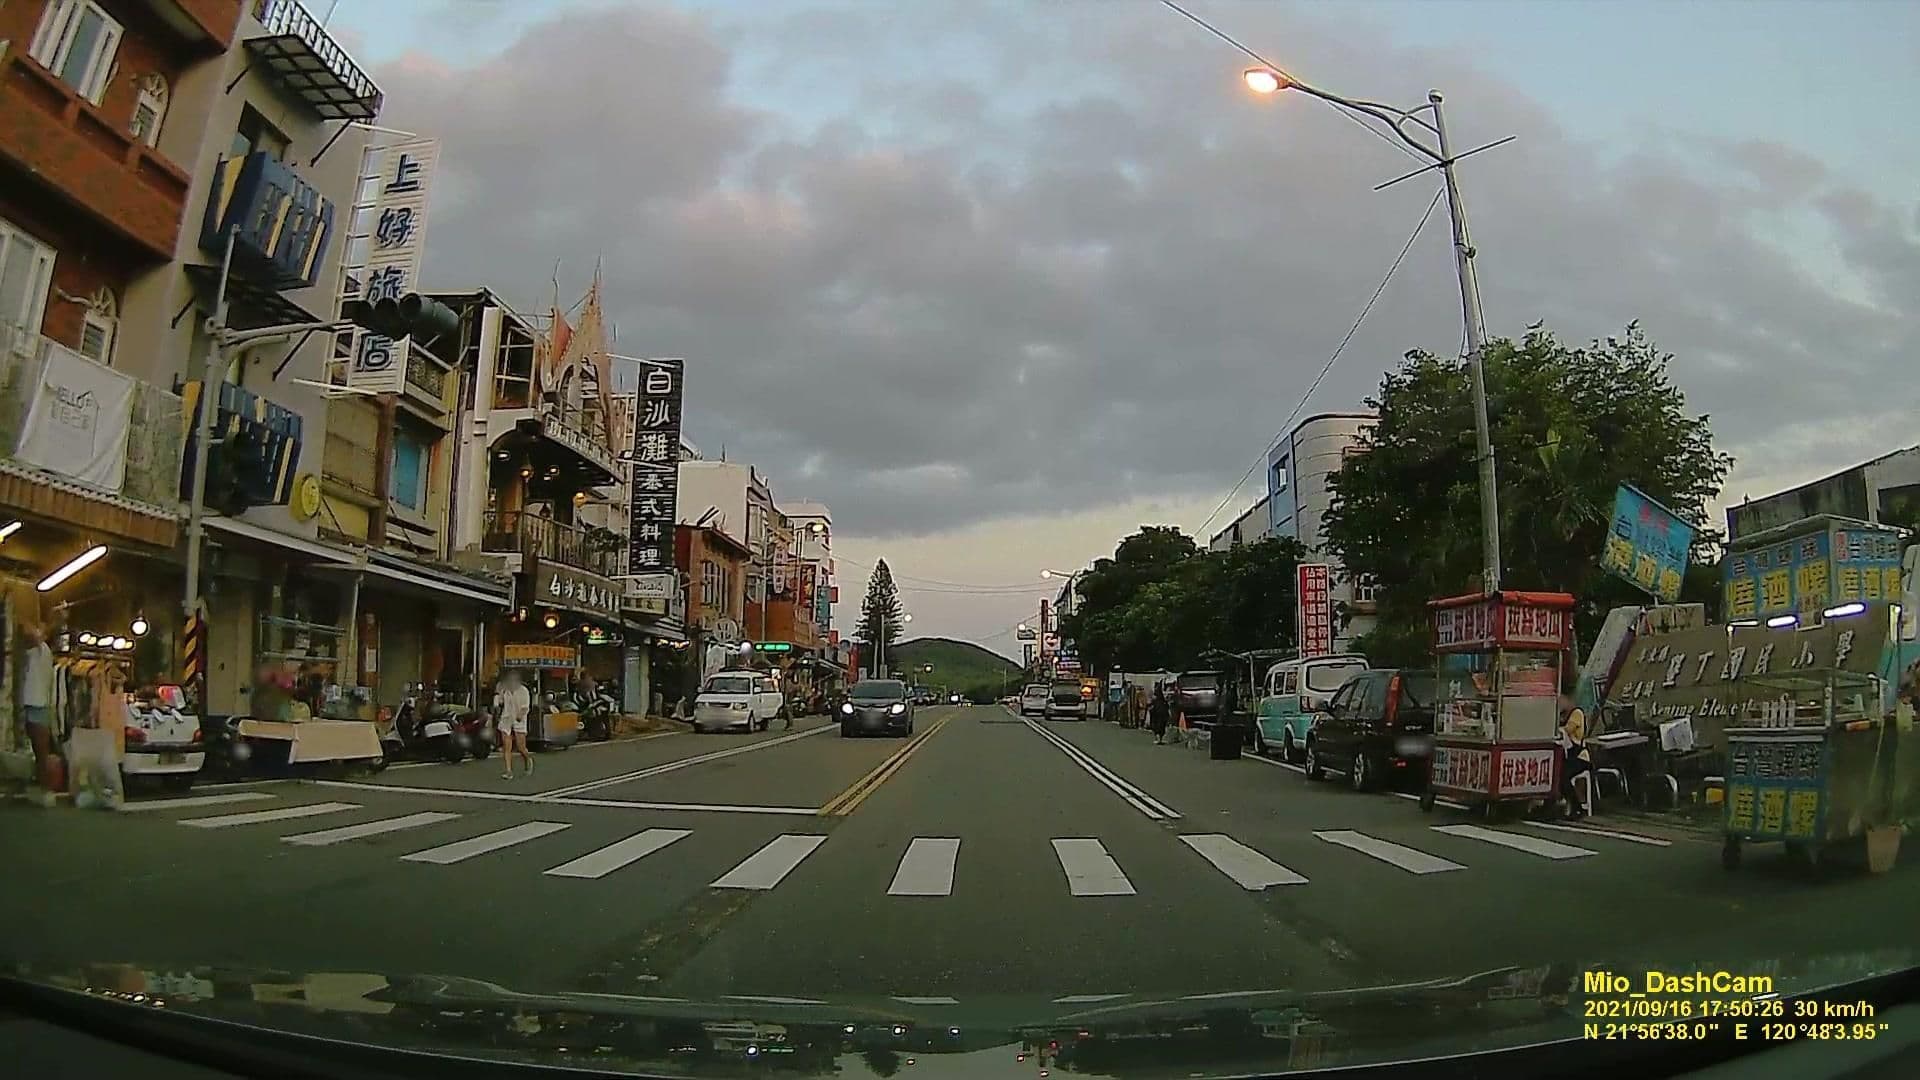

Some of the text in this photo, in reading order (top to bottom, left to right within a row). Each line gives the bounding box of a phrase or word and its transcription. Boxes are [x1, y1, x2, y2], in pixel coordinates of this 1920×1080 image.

[360, 153, 420, 371] 上好旅店
[637, 367, 673, 567] 白沙灘泰式料理
[1727, 559, 1828, 617] 燒酒螺
[1728, 785, 1819, 837] 燒酒螺
